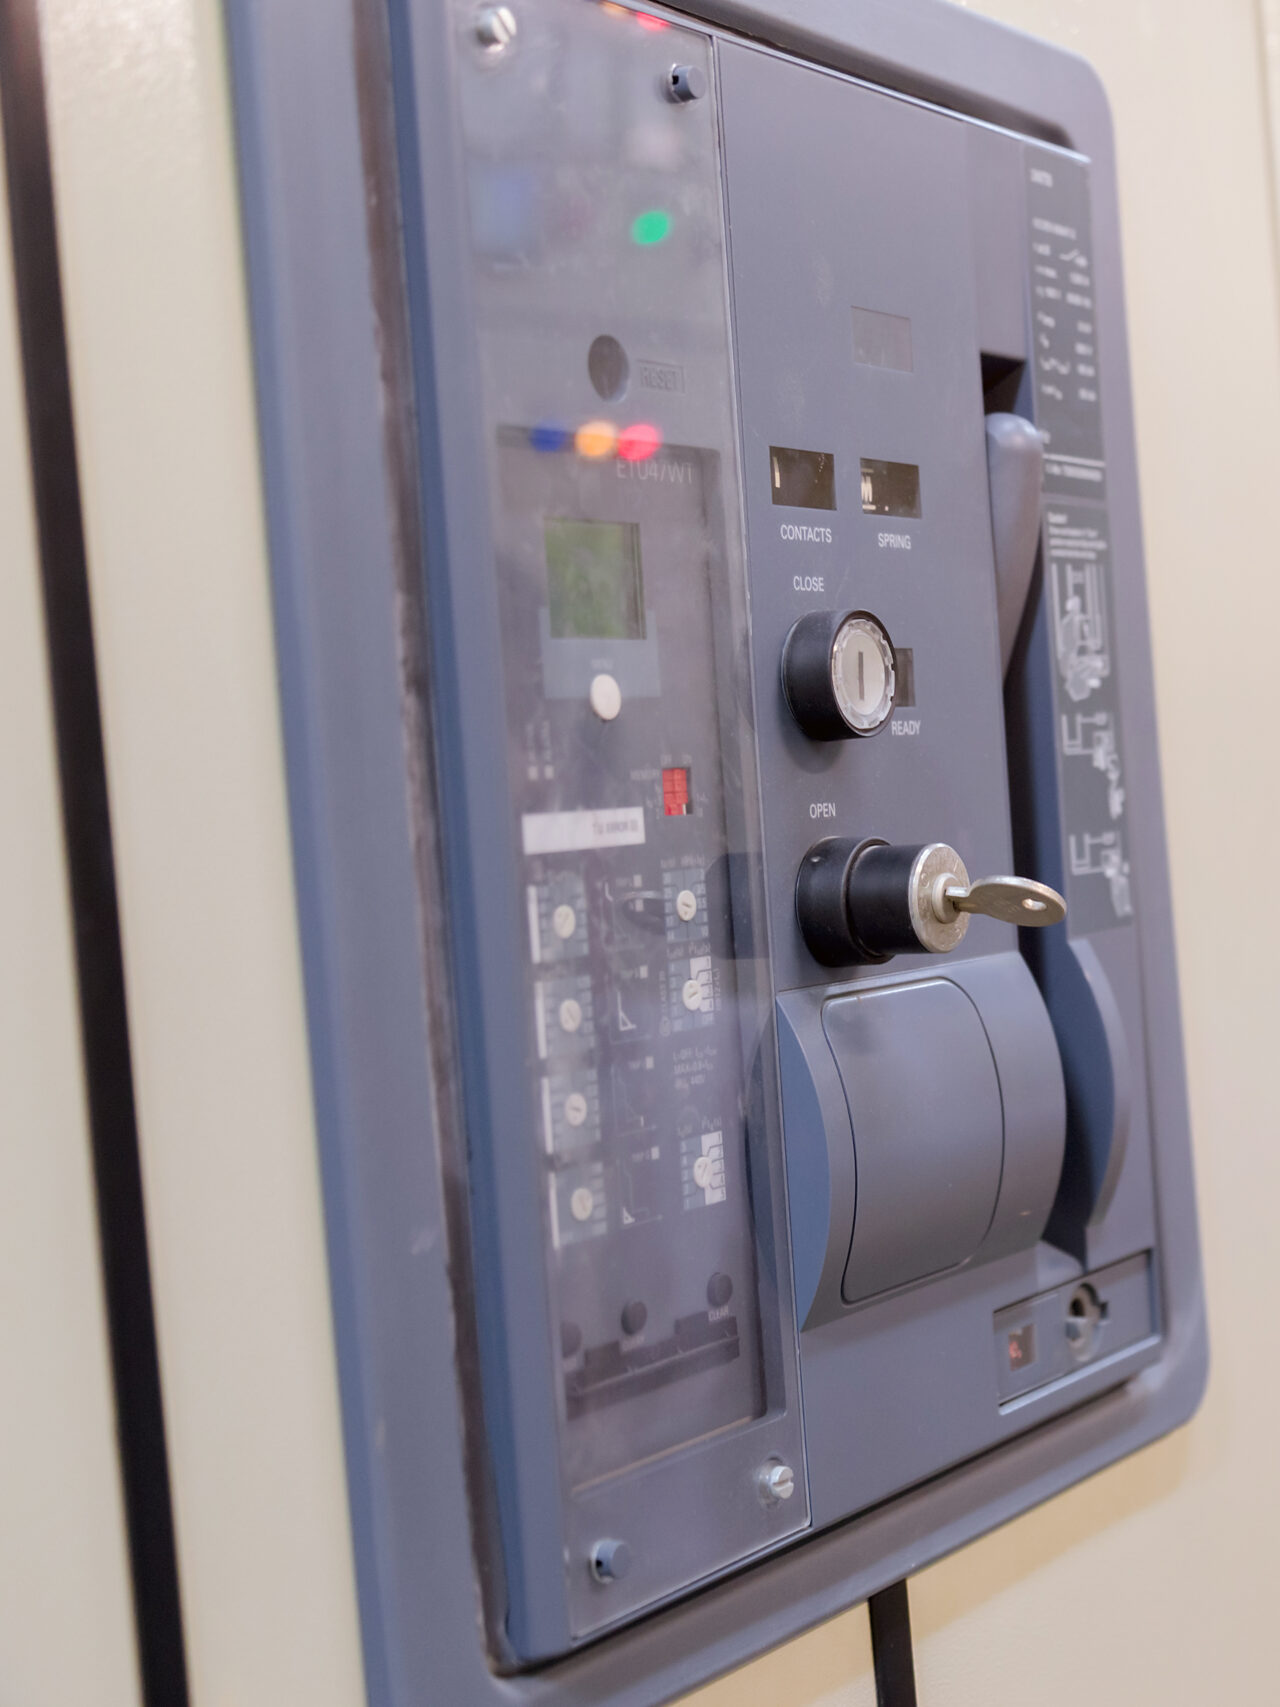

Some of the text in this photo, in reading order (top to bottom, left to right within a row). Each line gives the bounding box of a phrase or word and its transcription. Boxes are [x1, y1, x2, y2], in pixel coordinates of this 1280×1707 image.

[780, 524, 832, 543] CONTACTS
[878, 533, 911, 550] SPRING
[793, 575, 824, 592] CLOSE
[891, 720, 921, 736] READY
[809, 803, 836, 819] OPEN
